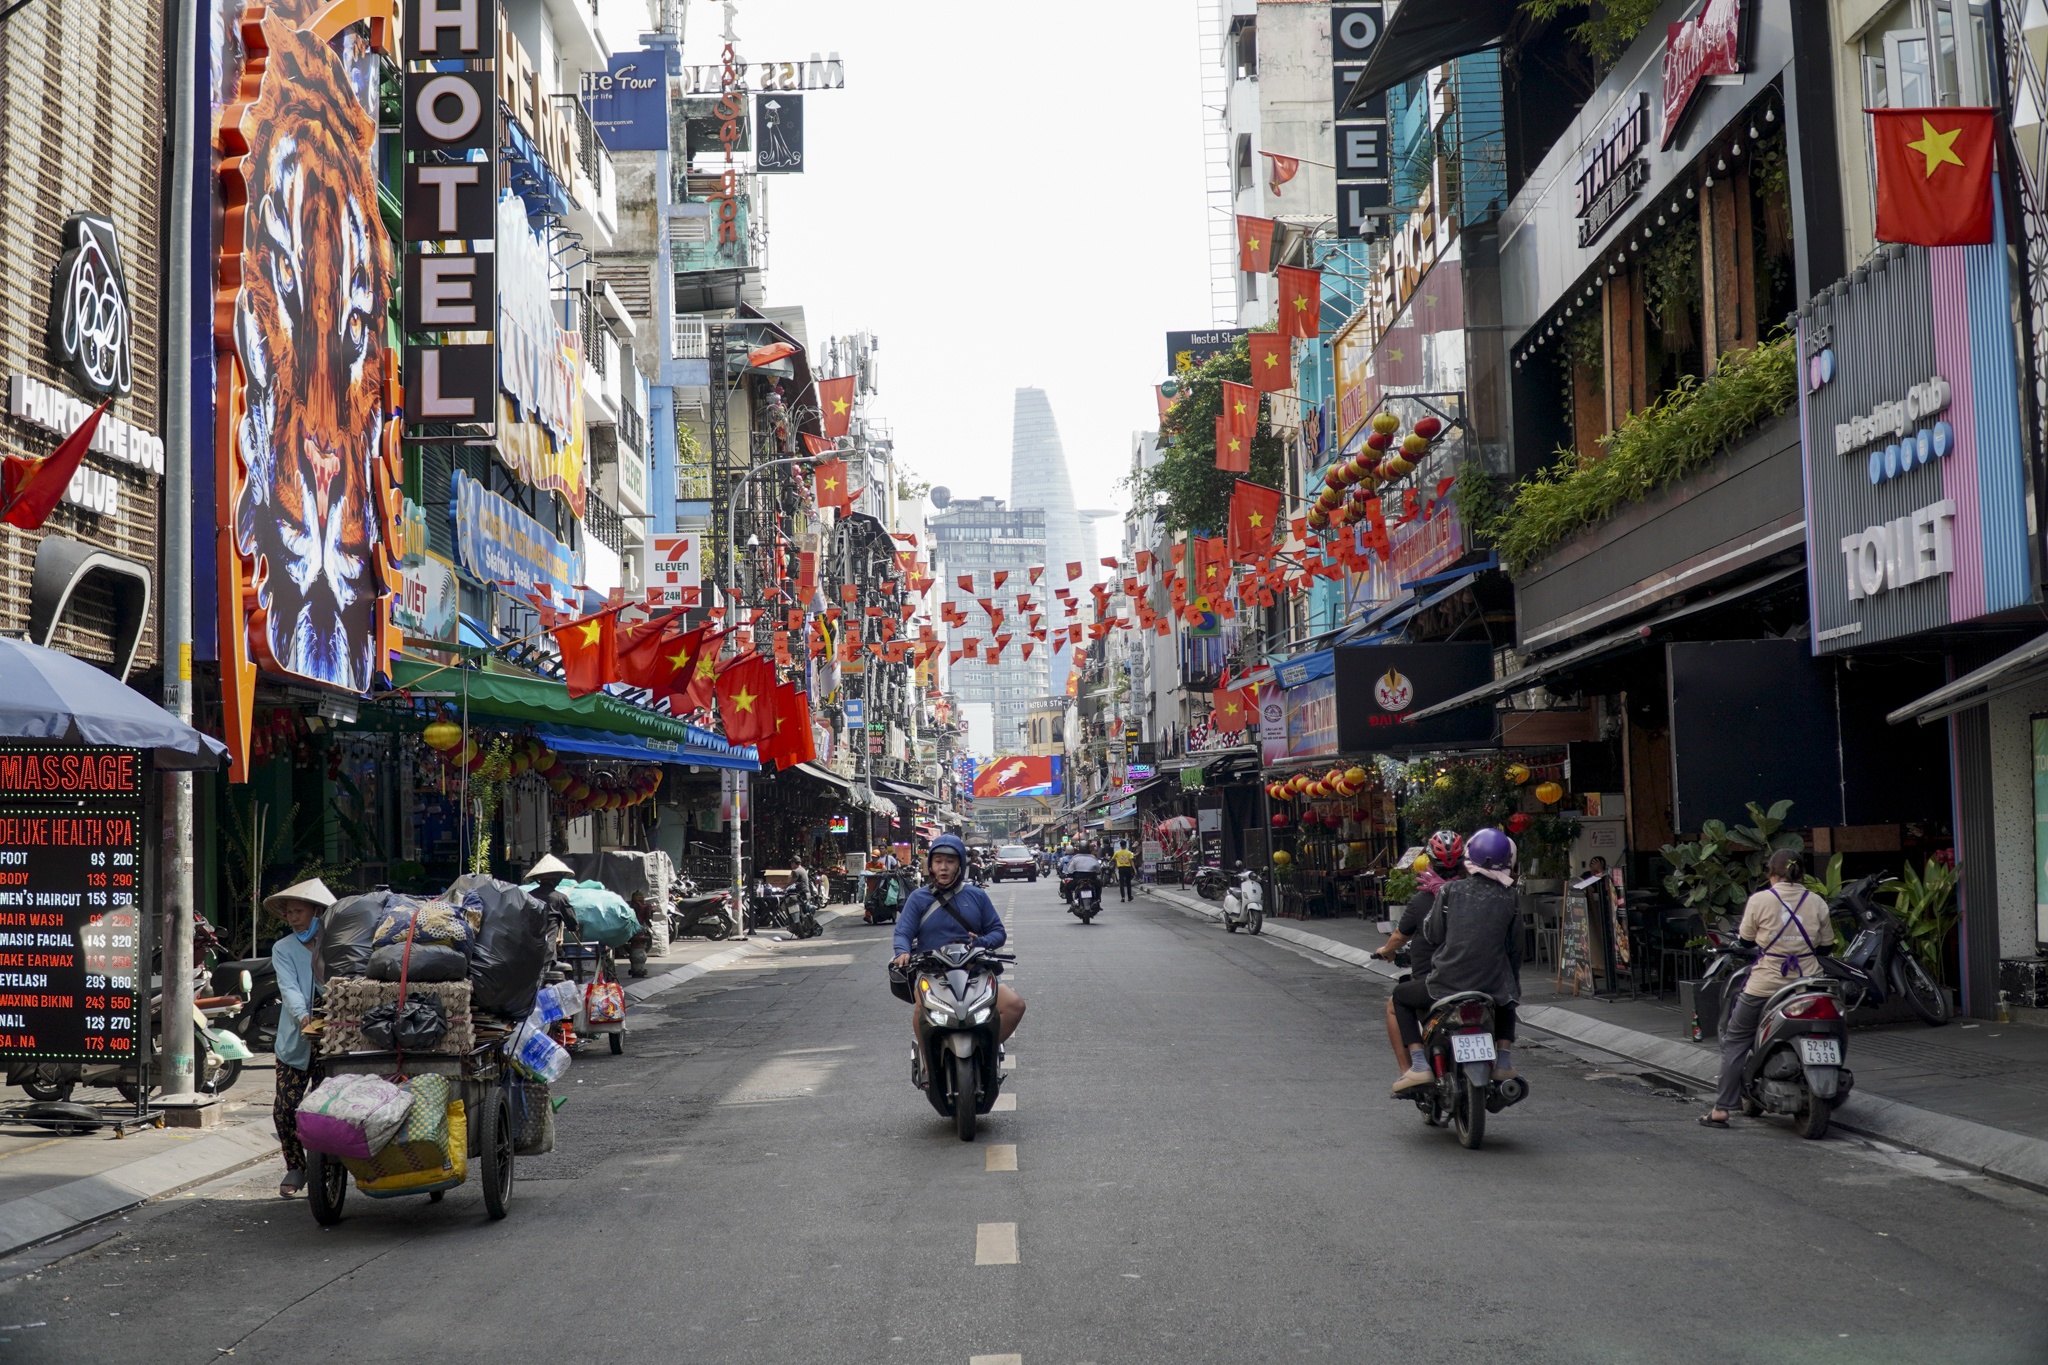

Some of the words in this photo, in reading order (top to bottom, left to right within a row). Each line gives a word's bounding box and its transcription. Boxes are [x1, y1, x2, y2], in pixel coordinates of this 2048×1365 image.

[614, 64, 656, 90] Tour
[707, 92, 742, 245] Saigon
[417, 0, 483, 416] HOTEL
[1191, 333, 1219, 344] Hostel
[11, 374, 67, 438] HAIR
[96, 411, 128, 459] THE
[128, 424, 165, 475] DOG
[1835, 400, 1913, 456] Refreshing
[1907, 377, 1951, 421] Club
[65, 464, 117, 516] CLUB
[1841, 499, 1955, 600] TOILET
[486, 544, 509, 579] Seafood
[655, 562, 689, 571] ELEVEN
[405, 573, 427, 622] VIỆT
[664, 591, 681, 601] 24H
[1131, 654, 1145, 716] HOTEL
[0, 755, 134, 790] MASSAGE
[0, 818, 48, 845] DELUXE
[52, 819, 102, 845] HEALTH
[106, 819, 133, 846] SPA
[0, 852, 28, 865] FOOT
[91, 852, 106, 867] 9$
[113, 853, 133, 866] 200
[0, 872, 29, 885] BODY
[87, 872, 107, 887] 13$
[112, 873, 133, 887] 290
[0, 889, 34, 906] MEN'S
[36, 893, 81, 906] HAIRCUT
[87, 891, 107, 906] 15$
[112, 892, 133, 905] 350
[0, 913, 26, 926] HAIR
[30, 914, 63, 926] WASH
[112, 914, 132, 927] 220
[37, 933, 74, 947] FACIAL
[87, 933, 106, 949] 14$
[111, 935, 132, 948] 320
[0, 953, 24, 966] TAKE
[28, 954, 73, 967] EARWAX
[0, 973, 47, 988] EYELASH
[86, 975, 106, 990] 29$
[111, 975, 132, 989] 660
[0, 994, 39, 1008] WAXING
[41, 995, 73, 1008] BIKINI
[85, 995, 105, 1010] 24$
[110, 996, 131, 1009] 550
[0, 1014, 26, 1028] NAIL
[85, 1015, 105, 1030] 12$
[110, 1016, 131, 1030] 270
[0, 1034, 36, 1048] SANA
[85, 1036, 105, 1051] 17$
[110, 1037, 130, 1050] 400
[1458, 1036, 1487, 1049] 59-F1
[1807, 1040, 1835, 1052] 52-P4
[1457, 1048, 1493, 1061] 251.96
[1808, 1052, 1837, 1064] 4339
